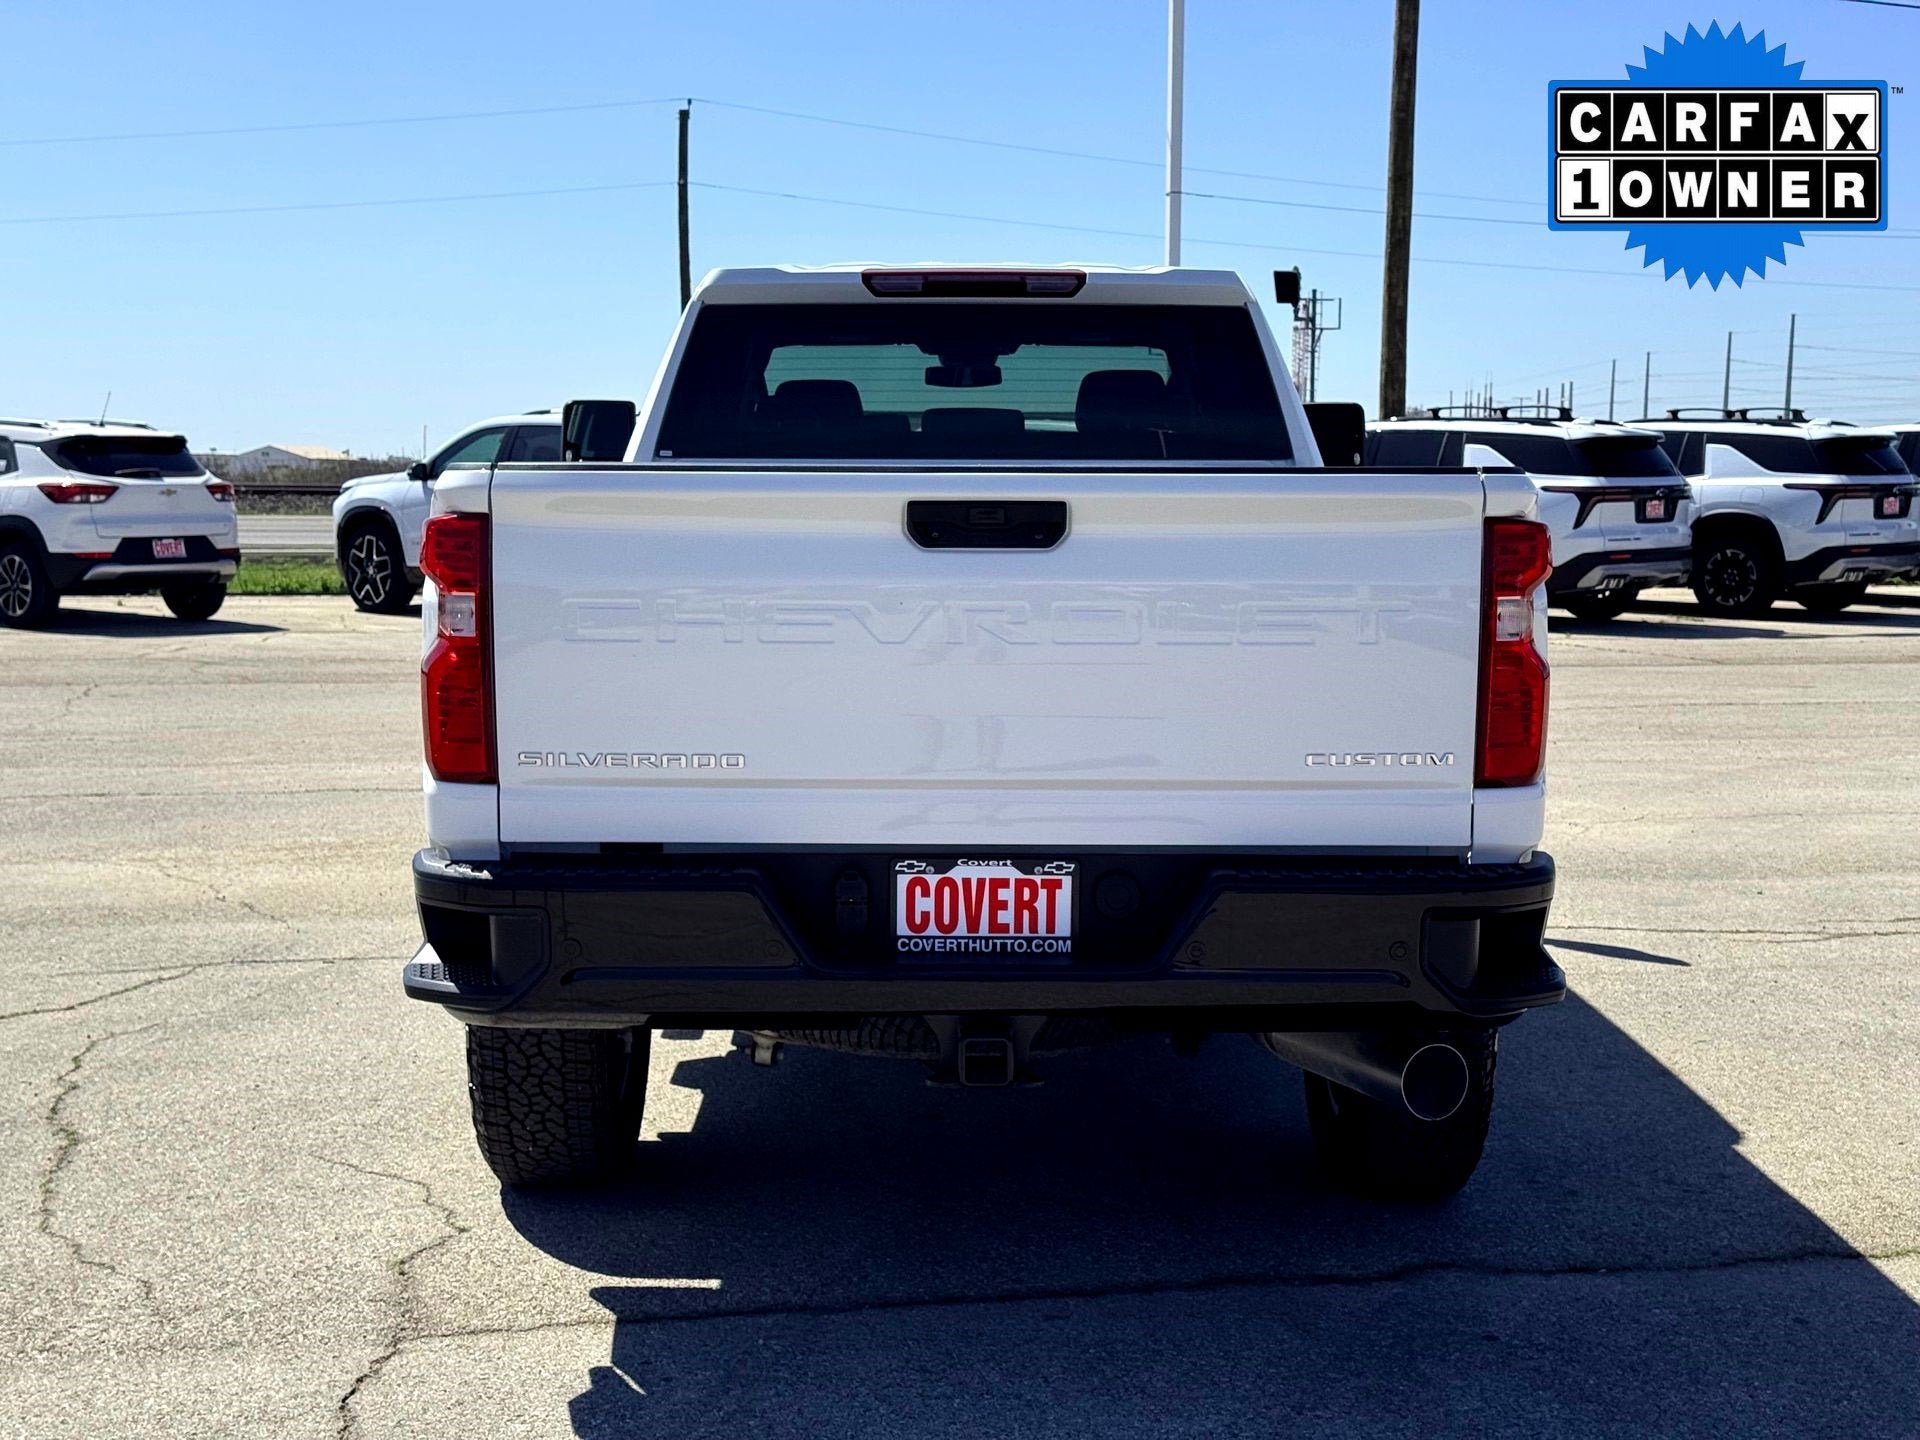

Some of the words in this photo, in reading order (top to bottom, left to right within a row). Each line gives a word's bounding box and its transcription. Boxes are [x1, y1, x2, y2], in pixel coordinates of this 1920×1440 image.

[563, 598, 1411, 645] CHEVROLET
[517, 751, 746, 769] SILVERADO
[1304, 752, 1455, 767] CUSTOM
[956, 858, 1013, 867] Covert
[905, 876, 1063, 935] COVERT
[897, 938, 1072, 953] COVERTHUTTO.COM
